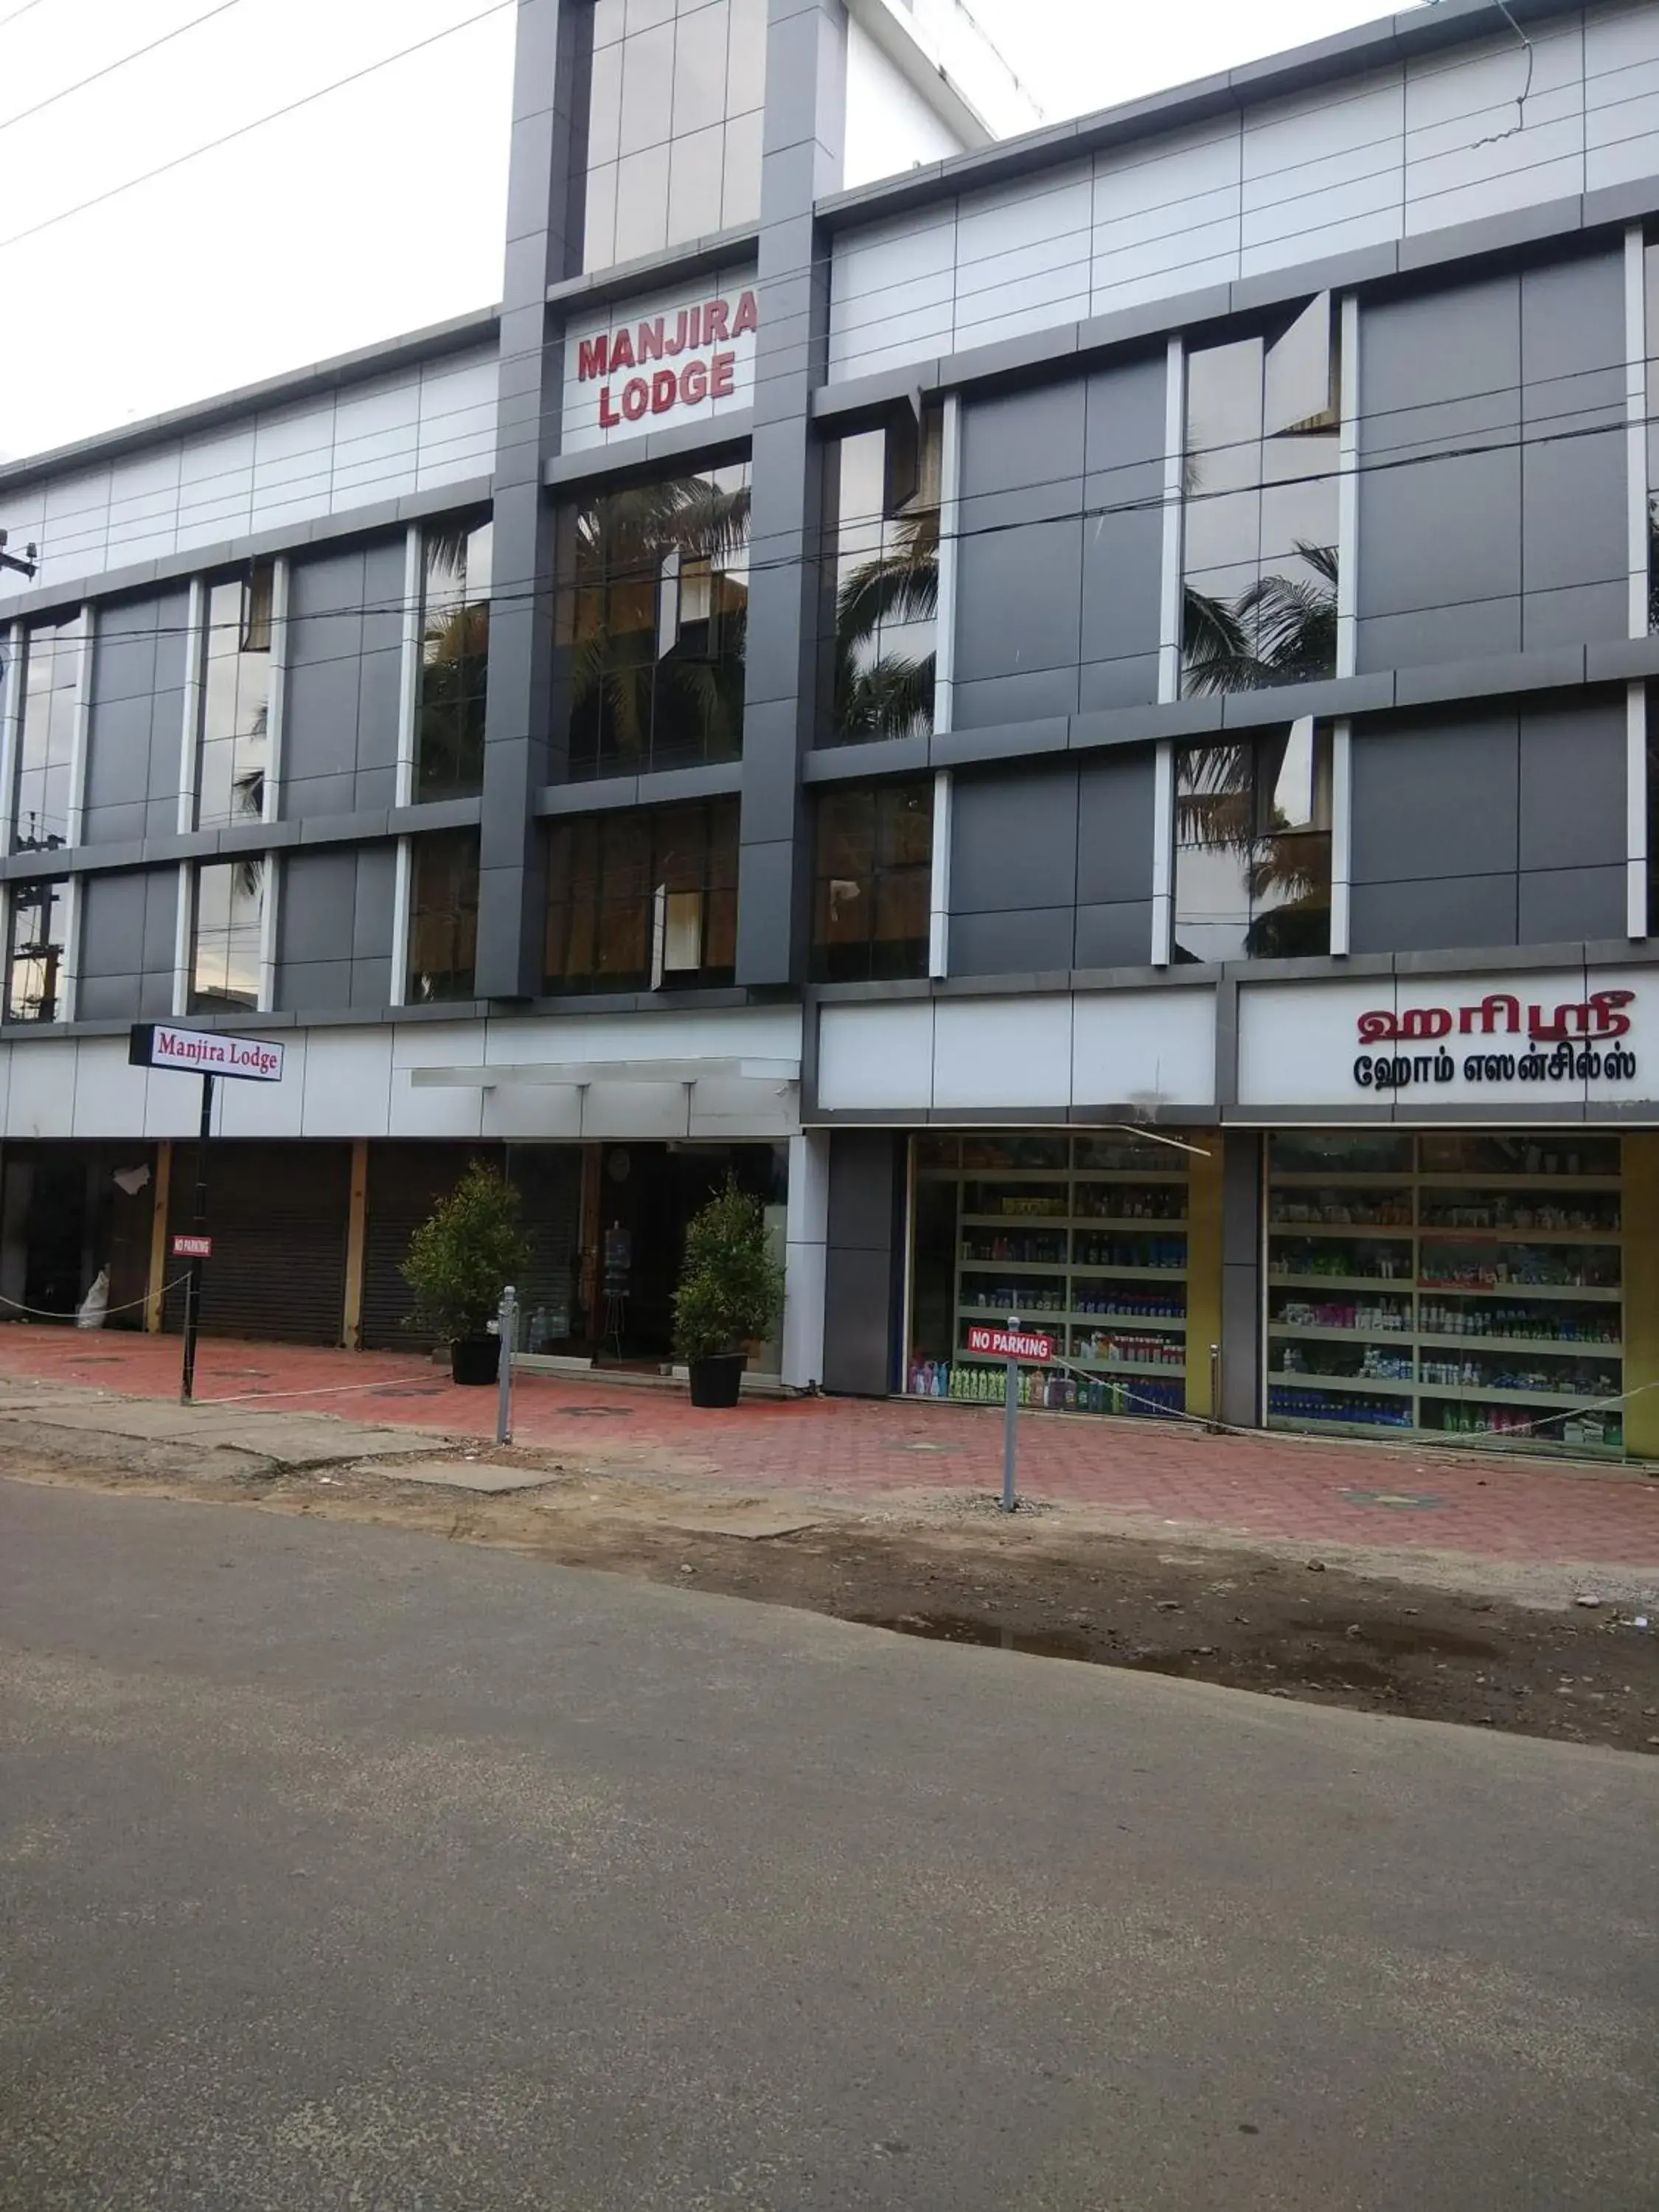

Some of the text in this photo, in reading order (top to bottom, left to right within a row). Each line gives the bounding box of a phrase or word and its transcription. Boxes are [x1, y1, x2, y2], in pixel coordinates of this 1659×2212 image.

[578, 291, 757, 382] MANJIRA
[599, 352, 735, 428] LODGE
[158, 1033, 276, 1074] Manjira Lodge
[1353, 1046, 1455, 1091] ஹோம்
[175, 1238, 184, 1251] NO
[972, 1331, 1048, 1357] NO PARKING
